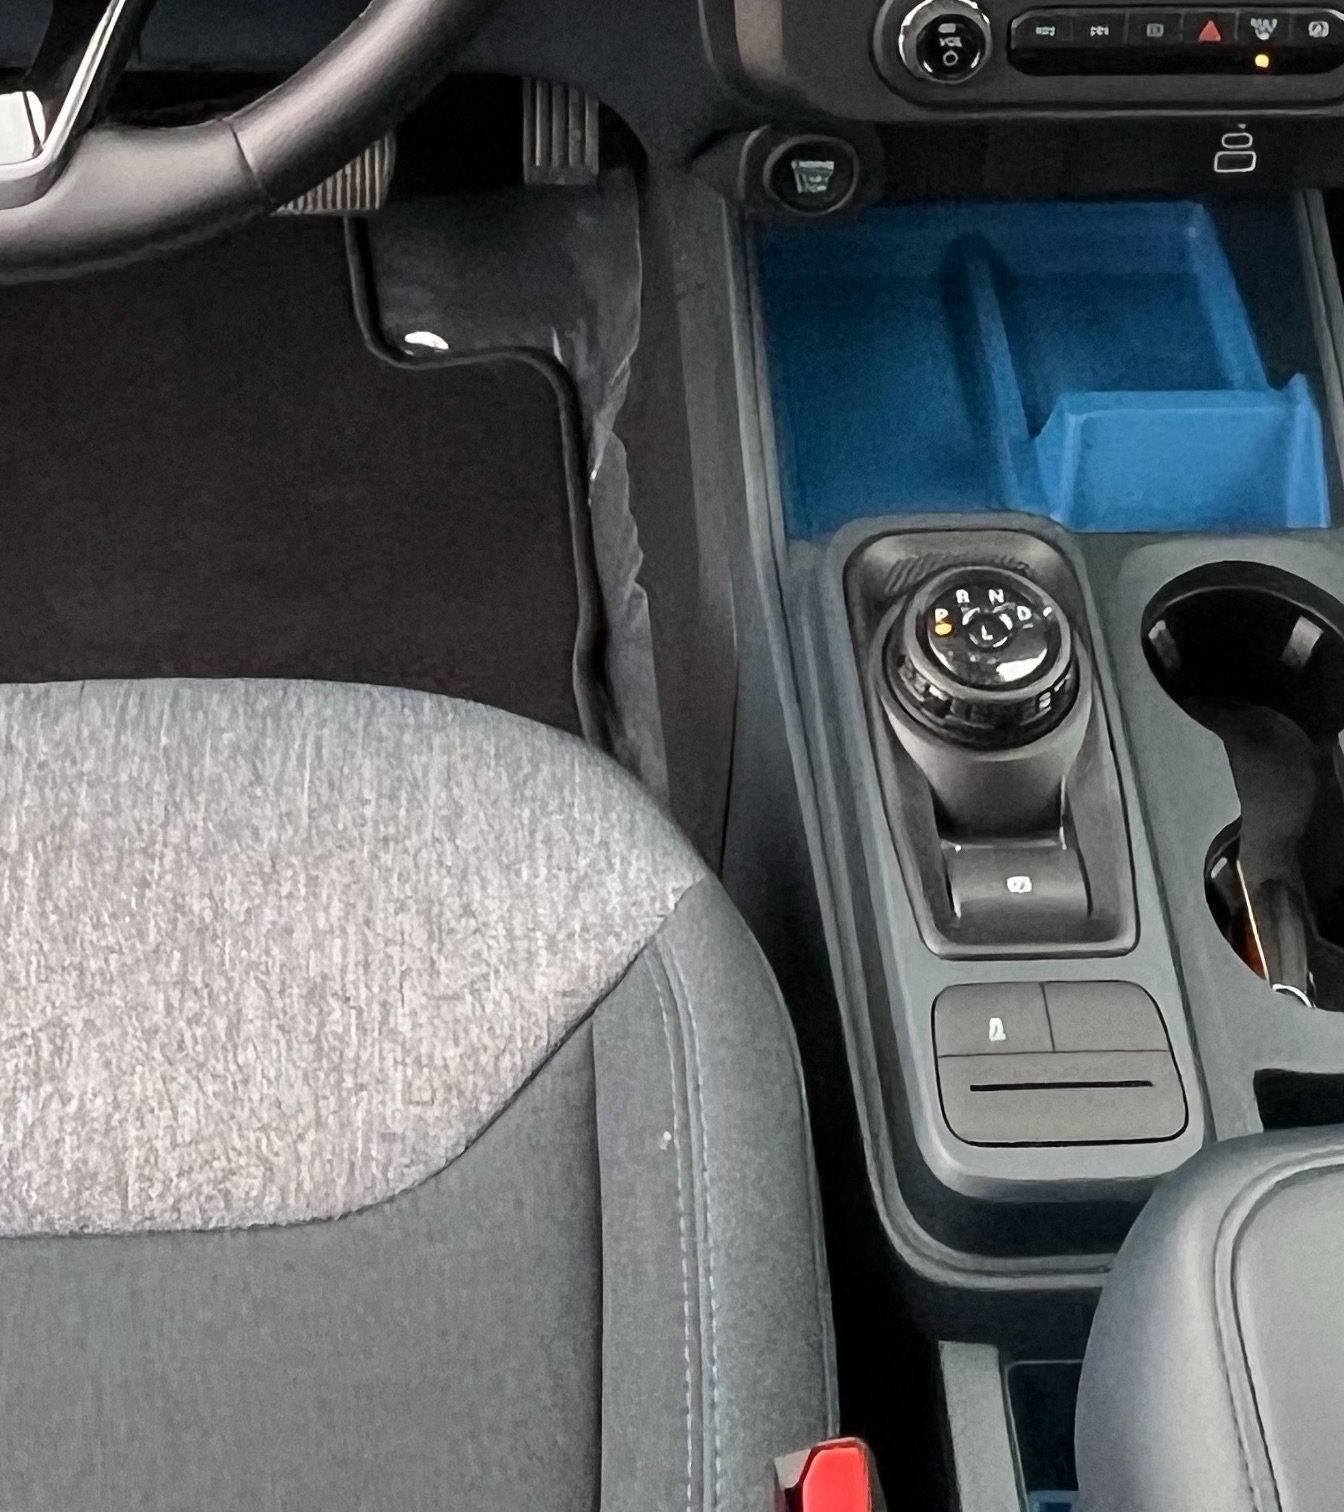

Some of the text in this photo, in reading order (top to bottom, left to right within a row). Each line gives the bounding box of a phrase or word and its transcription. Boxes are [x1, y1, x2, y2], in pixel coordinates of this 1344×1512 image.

[989, 589, 1004, 605] N
[935, 608, 949, 623] P
[1017, 605, 1032, 621] D
[981, 625, 993, 640] L
